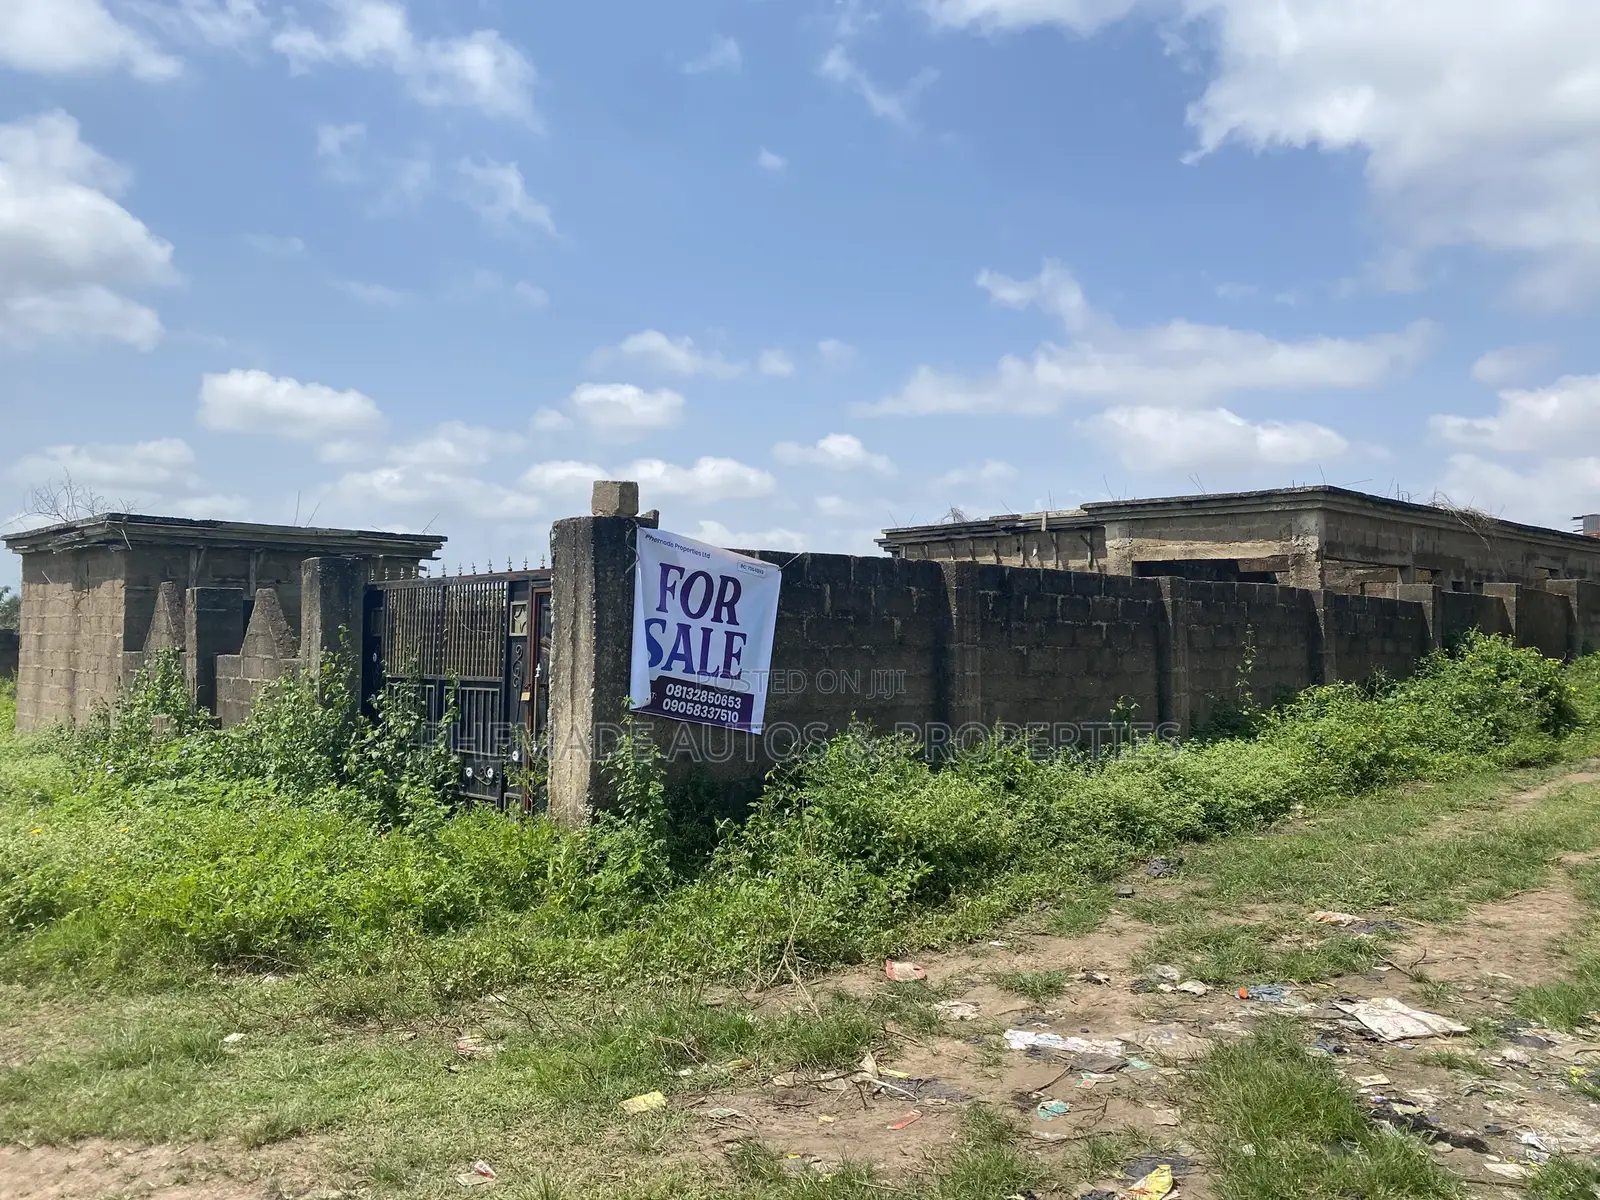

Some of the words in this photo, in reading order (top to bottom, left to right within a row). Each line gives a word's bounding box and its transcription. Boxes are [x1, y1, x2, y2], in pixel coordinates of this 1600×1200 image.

[674, 543, 701, 557] Properties
[655, 562, 742, 626] FOR
[645, 617, 747, 680] SALE
[665, 683, 742, 709] 08132850653
[662, 698, 739, 723] 09058337510
